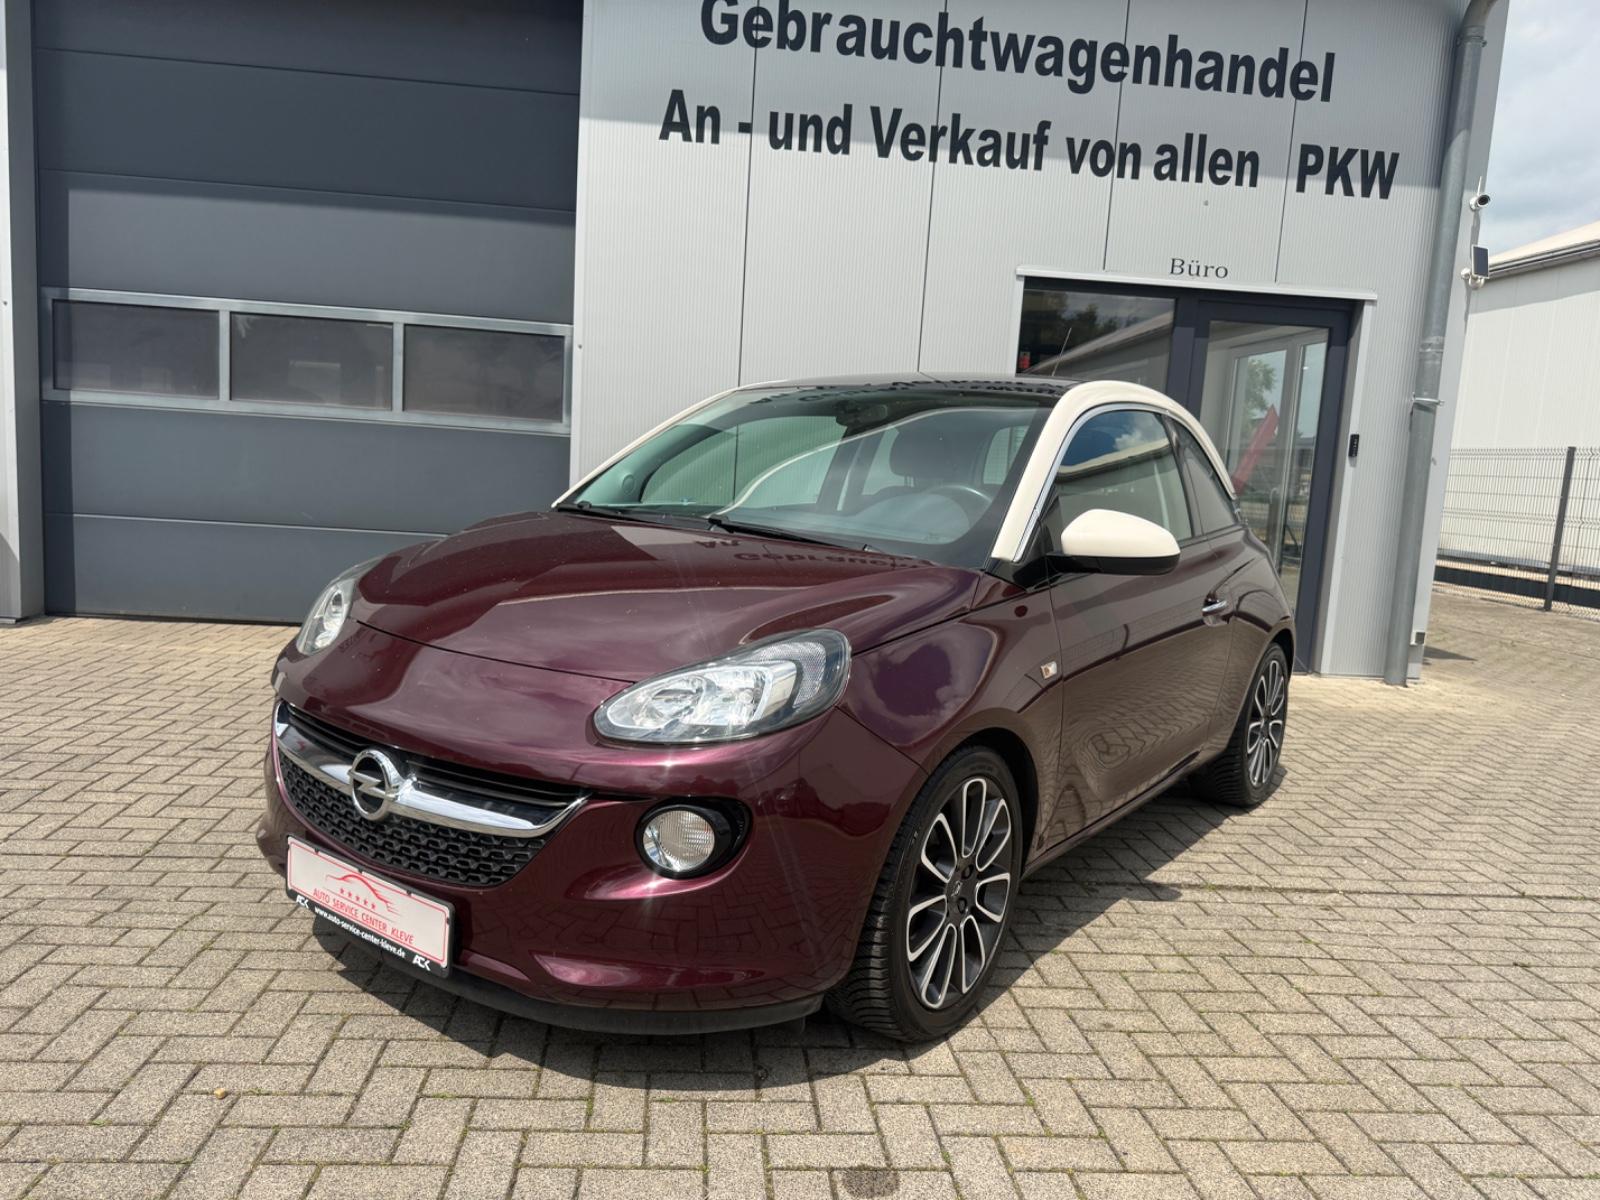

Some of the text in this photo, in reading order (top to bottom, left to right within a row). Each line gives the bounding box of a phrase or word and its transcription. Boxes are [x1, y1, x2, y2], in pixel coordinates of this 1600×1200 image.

[700, 0, 1336, 103] Gebrauchtwagenhandel
[658, 89, 721, 144] An
[768, 103, 853, 155] und
[869, 105, 1052, 171] Verkauf
[1065, 136, 1142, 180] von
[1153, 132, 1260, 188] allen
[1295, 143, 1400, 200] PKW
[1170, 257, 1228, 279] Büro
[313, 888, 415, 945] AUTO SERVICE CENTER KLEVE
[314, 906, 406, 959] www.auto-service-center-kleve.de
